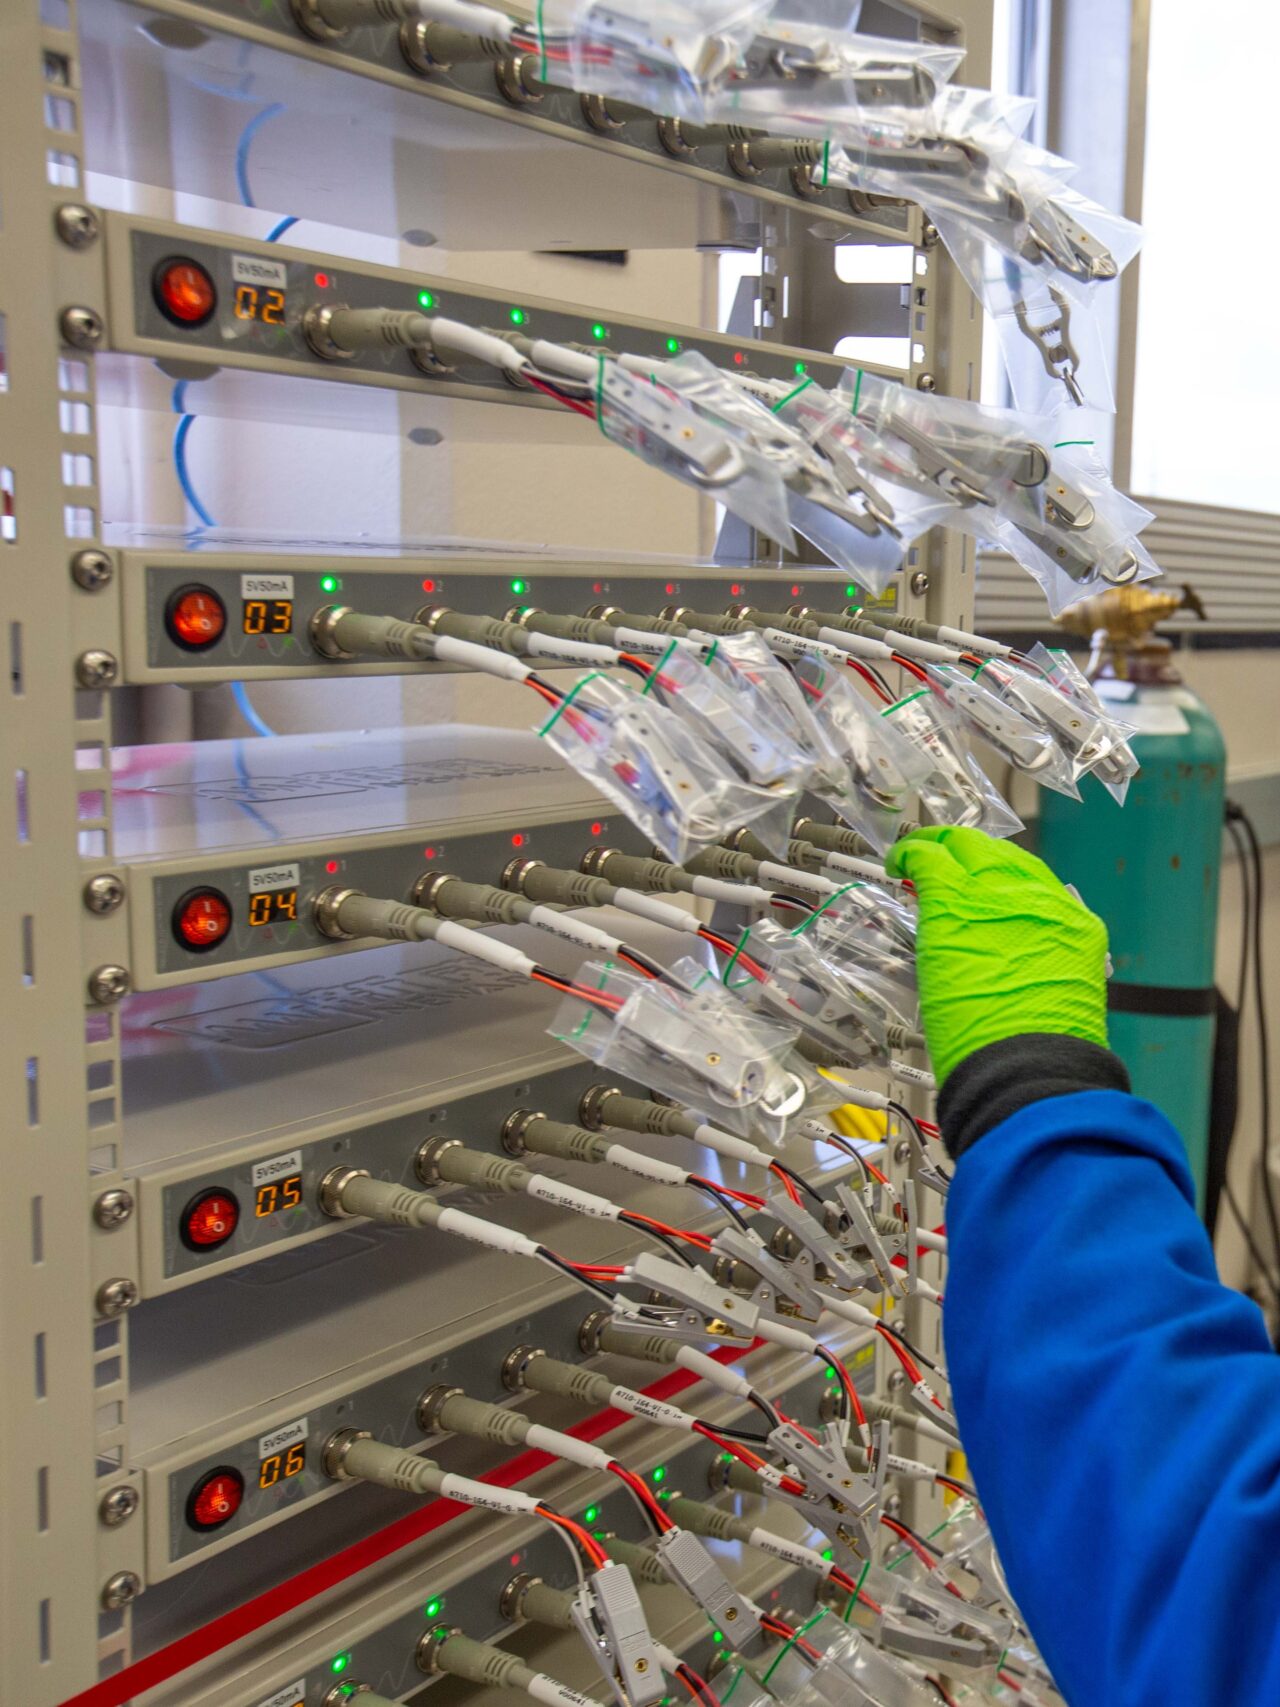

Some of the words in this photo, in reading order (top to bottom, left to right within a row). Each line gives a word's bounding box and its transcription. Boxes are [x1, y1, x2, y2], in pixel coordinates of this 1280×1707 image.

[237, 262, 281, 280] 5V50mA
[234, 286, 284, 325] 02
[246, 579, 289, 593] 5V50mA
[244, 602, 292, 634] 03
[253, 868, 294, 887] 5V50mA
[249, 892, 297, 927] 04
[256, 1158, 297, 1180] 5V50mA
[256, 1178, 300, 1218] 05
[263, 1425, 304, 1452] 5V50mA
[259, 1444, 304, 1488] 06
